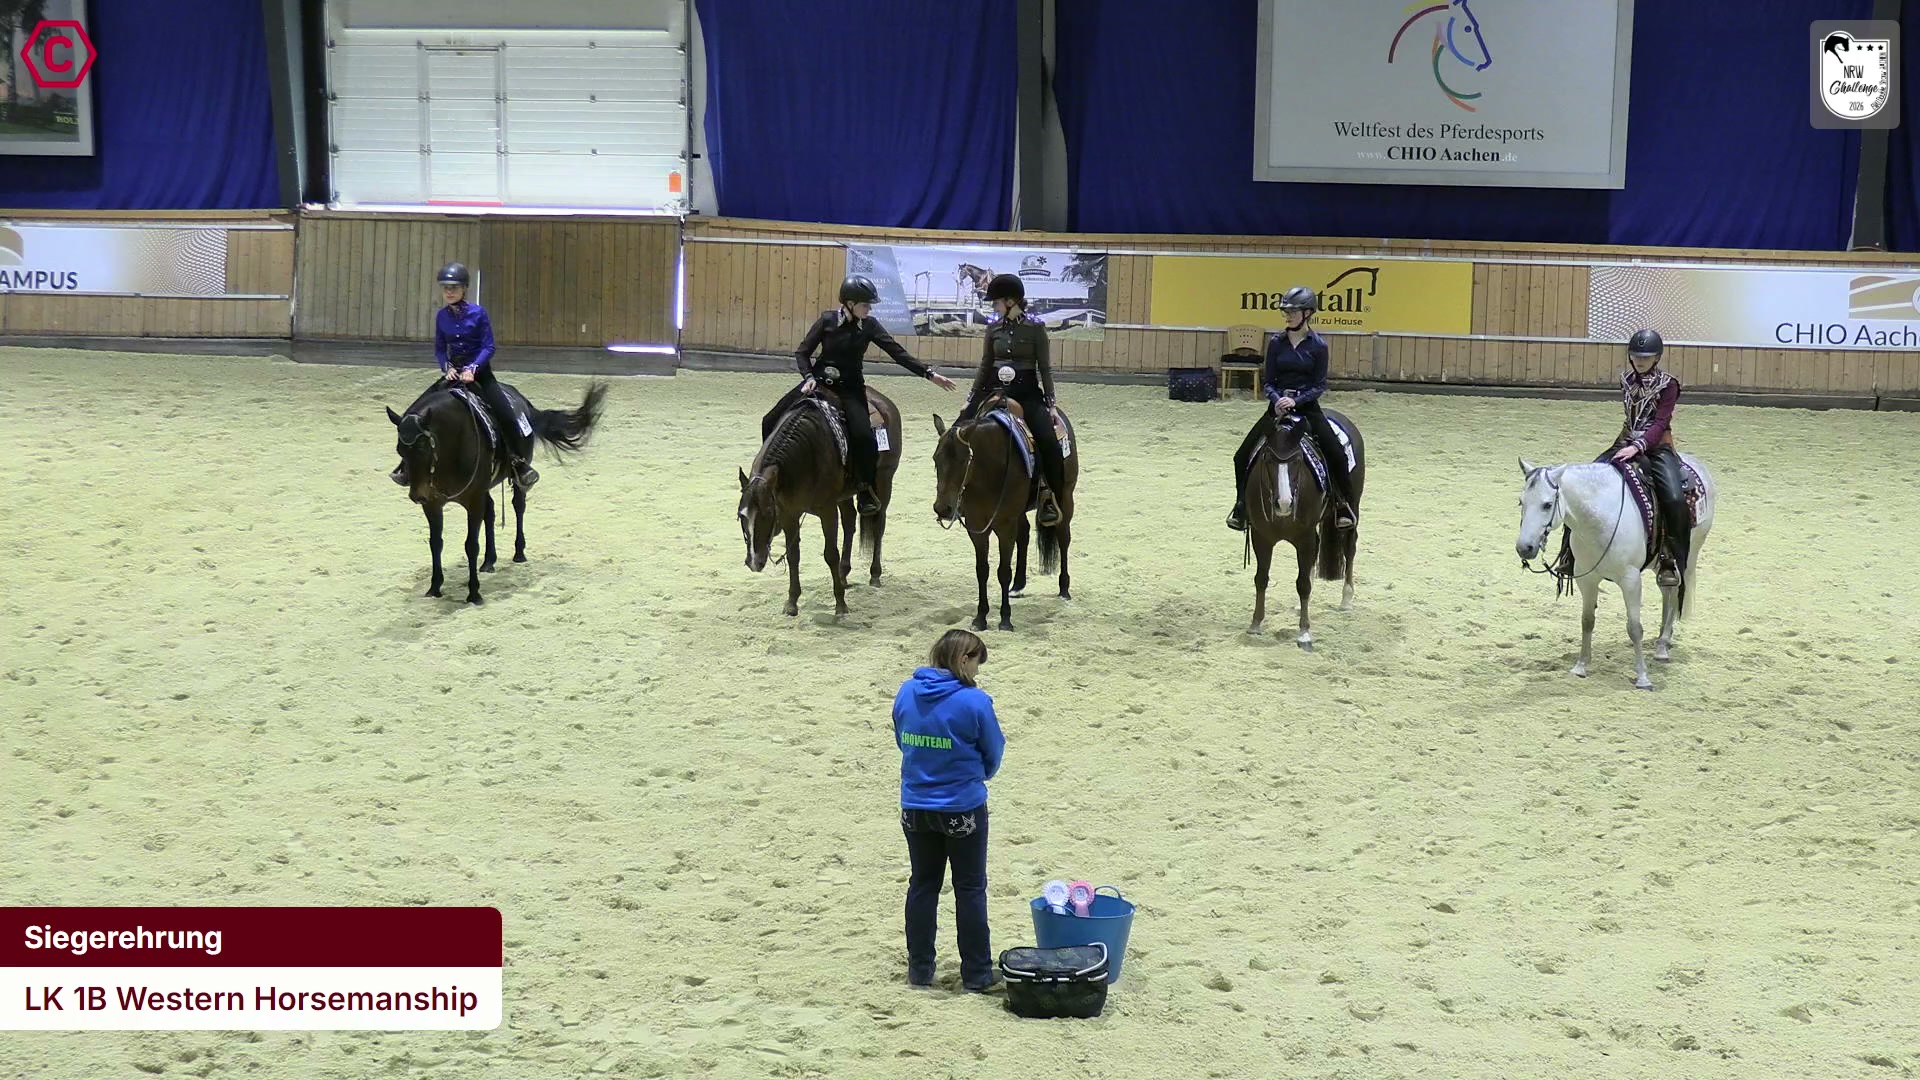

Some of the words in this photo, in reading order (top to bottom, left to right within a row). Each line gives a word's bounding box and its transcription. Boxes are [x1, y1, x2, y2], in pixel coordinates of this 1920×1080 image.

[1334, 121, 1401, 138] Weltfest
[1406, 122, 1434, 138] des
[1440, 123, 1544, 144] Pferdesports
[1240, 288, 1363, 312] matall
[1334, 317, 1363, 326] Hause
[1775, 322, 1848, 345] CHIO
[1854, 324, 1920, 347] Aach
